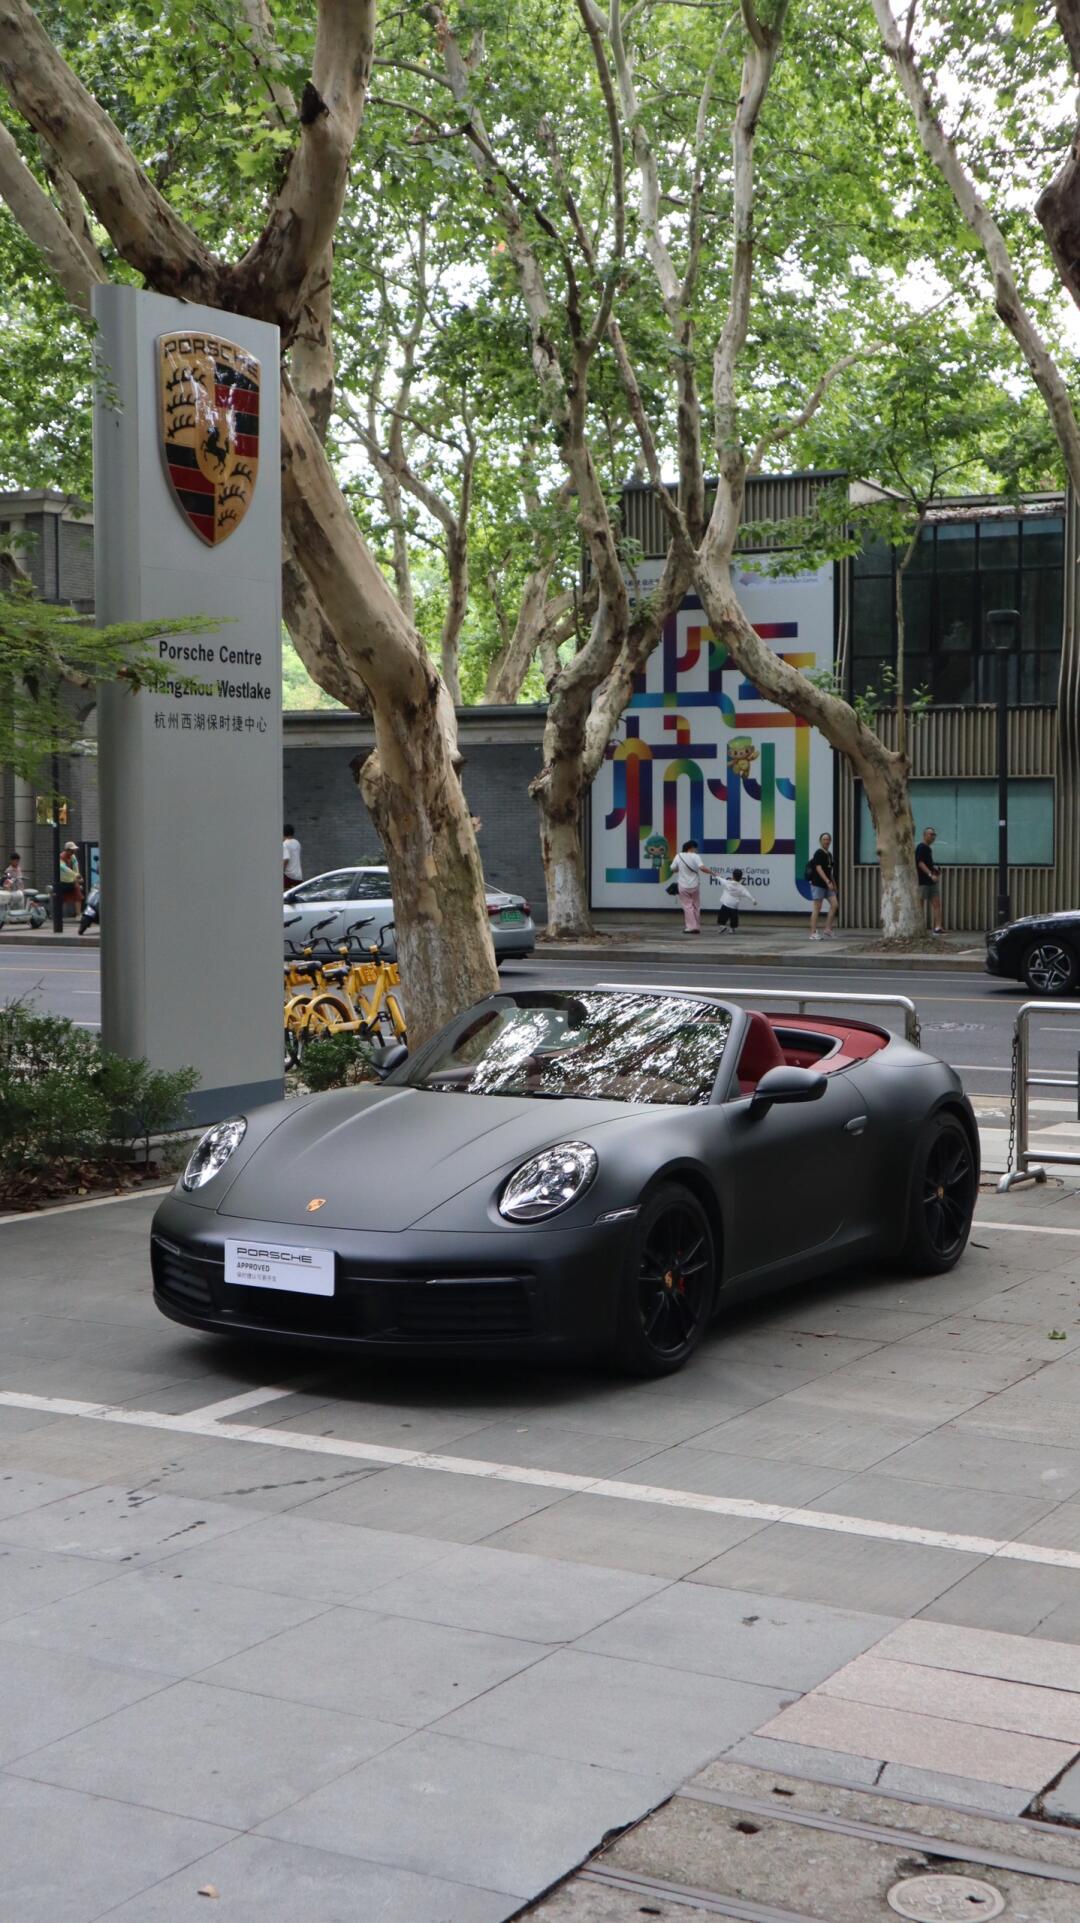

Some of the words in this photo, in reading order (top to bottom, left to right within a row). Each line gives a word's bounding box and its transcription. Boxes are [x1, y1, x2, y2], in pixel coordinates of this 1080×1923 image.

[159, 640, 215, 662] Porsche
[219, 645, 262, 666] Centre
[216, 680, 271, 700] Westlake
[154, 711, 268, 733] 杭州西湖保时捷中心
[236, 1247, 312, 1264] PORSCHE
[236, 1262, 270, 1272] APPROVED
